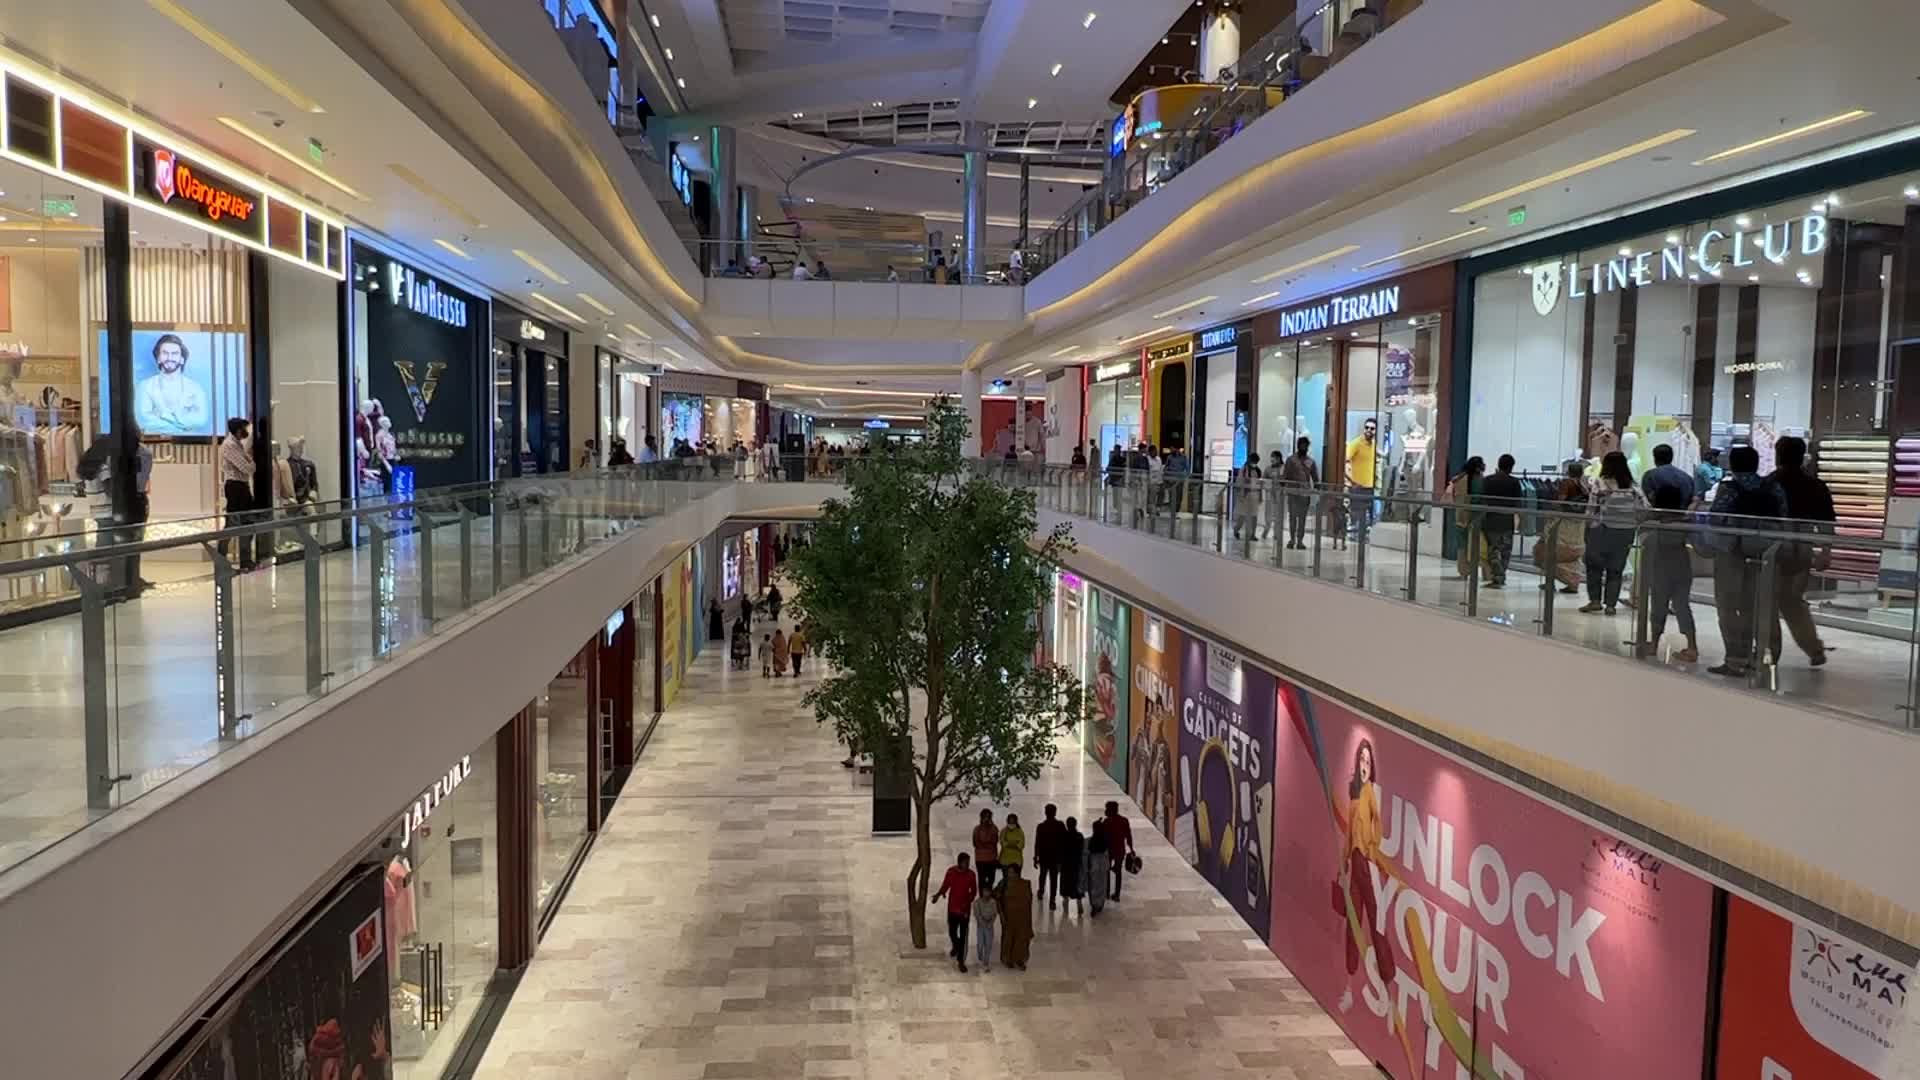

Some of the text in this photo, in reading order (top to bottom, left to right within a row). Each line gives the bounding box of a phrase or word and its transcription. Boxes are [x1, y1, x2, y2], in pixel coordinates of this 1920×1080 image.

[177, 166, 249, 220] Manyavar
[1568, 214, 1827, 299] LINEN CLUB
[1280, 286, 1399, 337] INDIAN TERRAIN
[1093, 626, 1119, 667] FOOD
[1135, 663, 1175, 717] CINEMA
[1184, 698, 1260, 779] GADGETS
[1232, 711, 1242, 725] OF
[1371, 783, 1607, 1003] UNLOCK
[1614, 859, 1660, 892] MALL
[1368, 860, 1510, 1034] YOUR
[1362, 944, 1525, 1080] STY
[1838, 991, 1852, 1002] of
